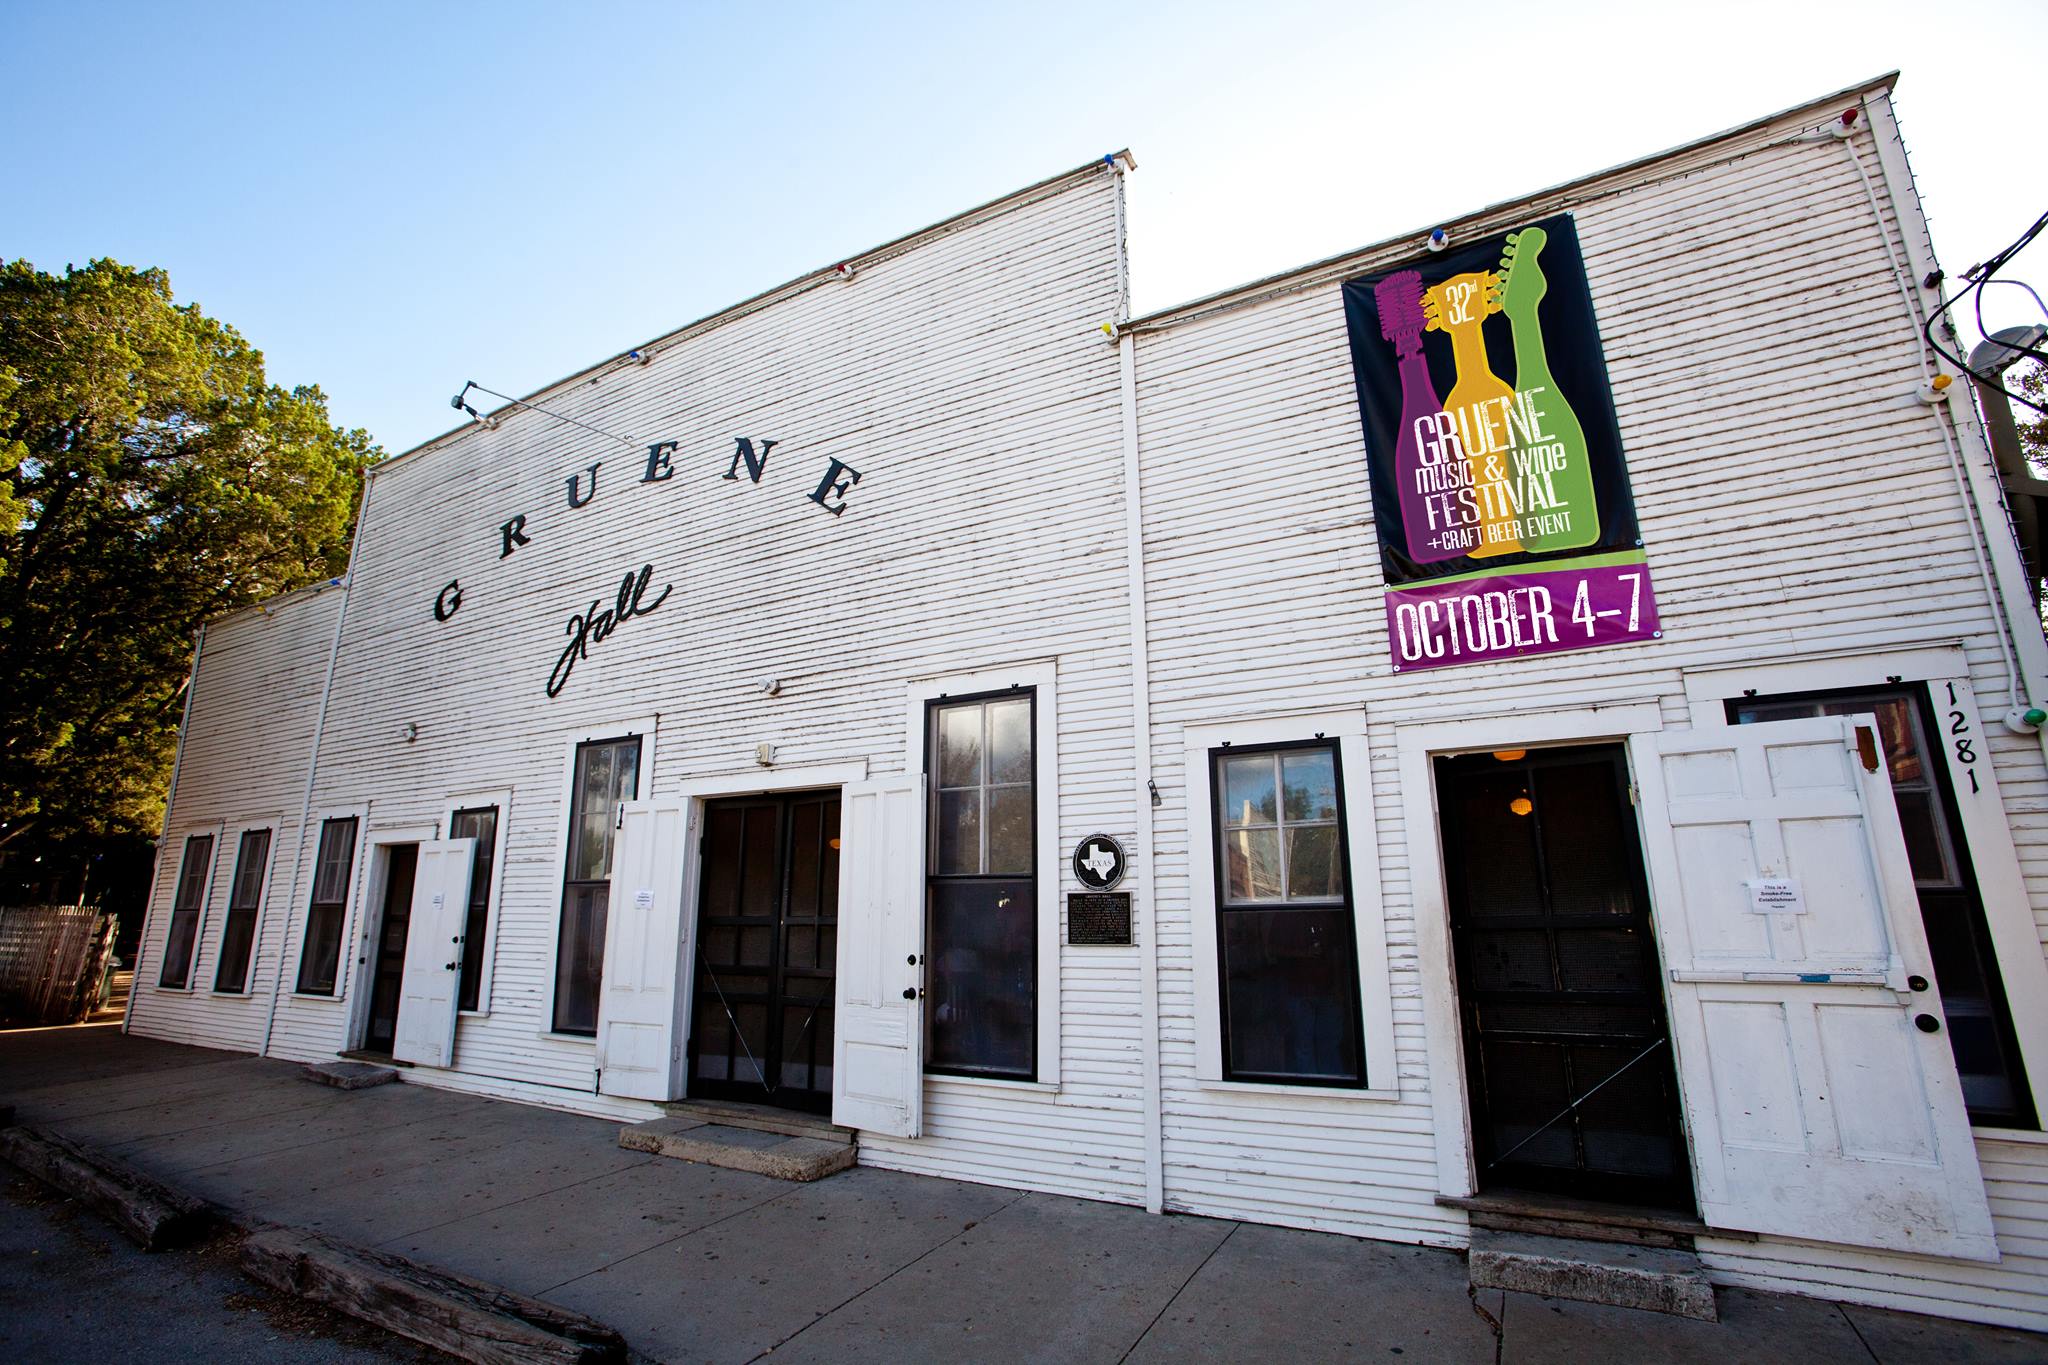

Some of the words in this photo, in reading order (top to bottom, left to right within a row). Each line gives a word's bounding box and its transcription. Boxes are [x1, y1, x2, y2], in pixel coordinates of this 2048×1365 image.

[1445, 279, 1478, 325] 32nd
[1413, 386, 1556, 468] GRUENE
[1425, 471, 1569, 531] FESTIVAL
[1483, 455, 1505, 482] &
[434, 436, 862, 623] GRUENE
[1487, 519, 1524, 544] BEER
[1527, 511, 1572, 538] EVENT
[546, 564, 673, 699] Hall
[1395, 586, 1560, 662] OCTOBER
[1945, 681, 1980, 795] 1281
[1087, 859, 1112, 868] TEXAS
